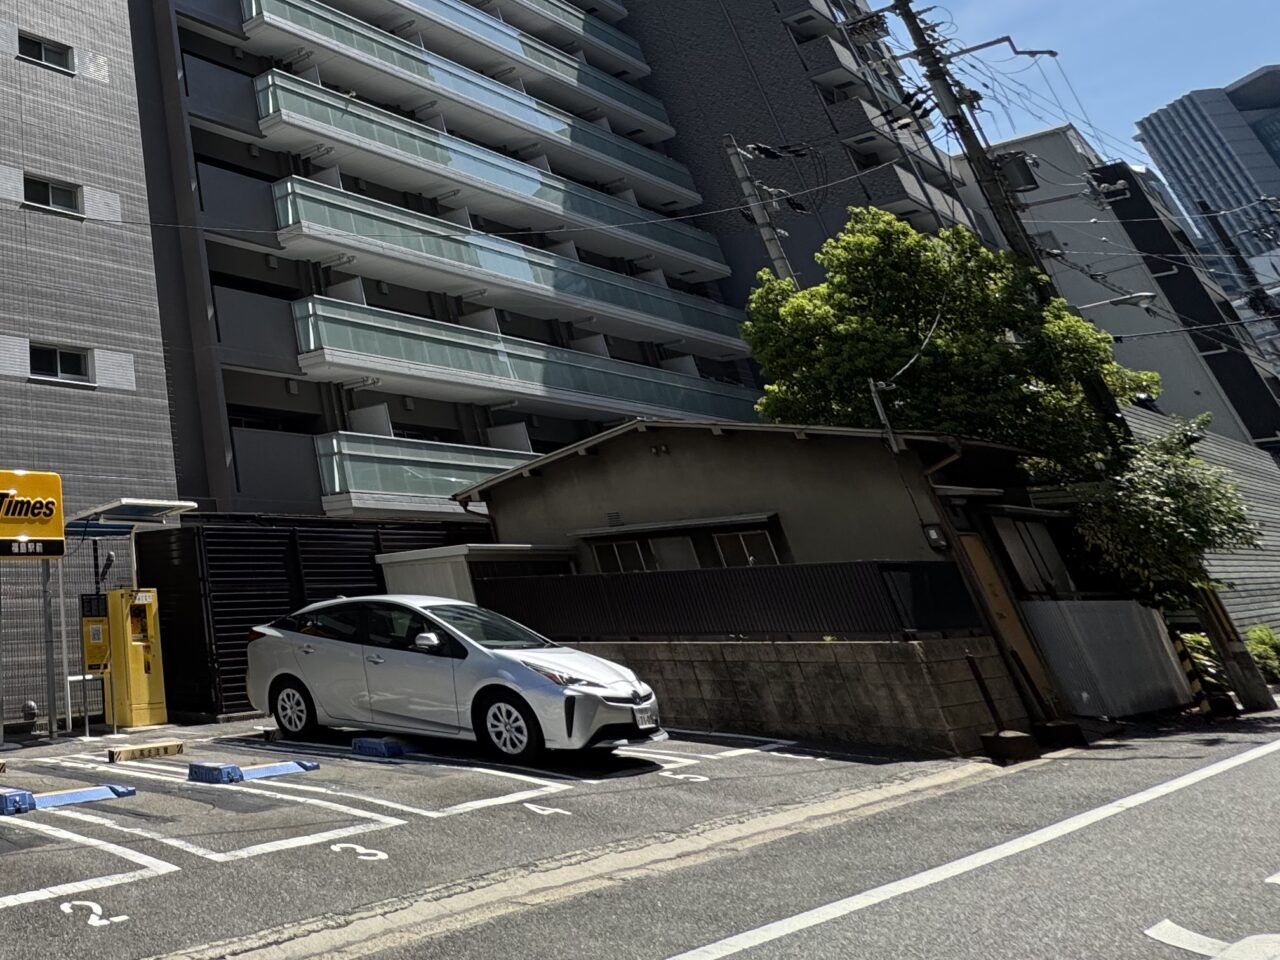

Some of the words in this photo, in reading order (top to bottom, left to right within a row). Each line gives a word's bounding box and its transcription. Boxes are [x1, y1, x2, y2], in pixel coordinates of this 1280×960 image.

[523, 802, 574, 816] 4
[329, 842, 389, 861] 3
[59, 899, 131, 927] 2
